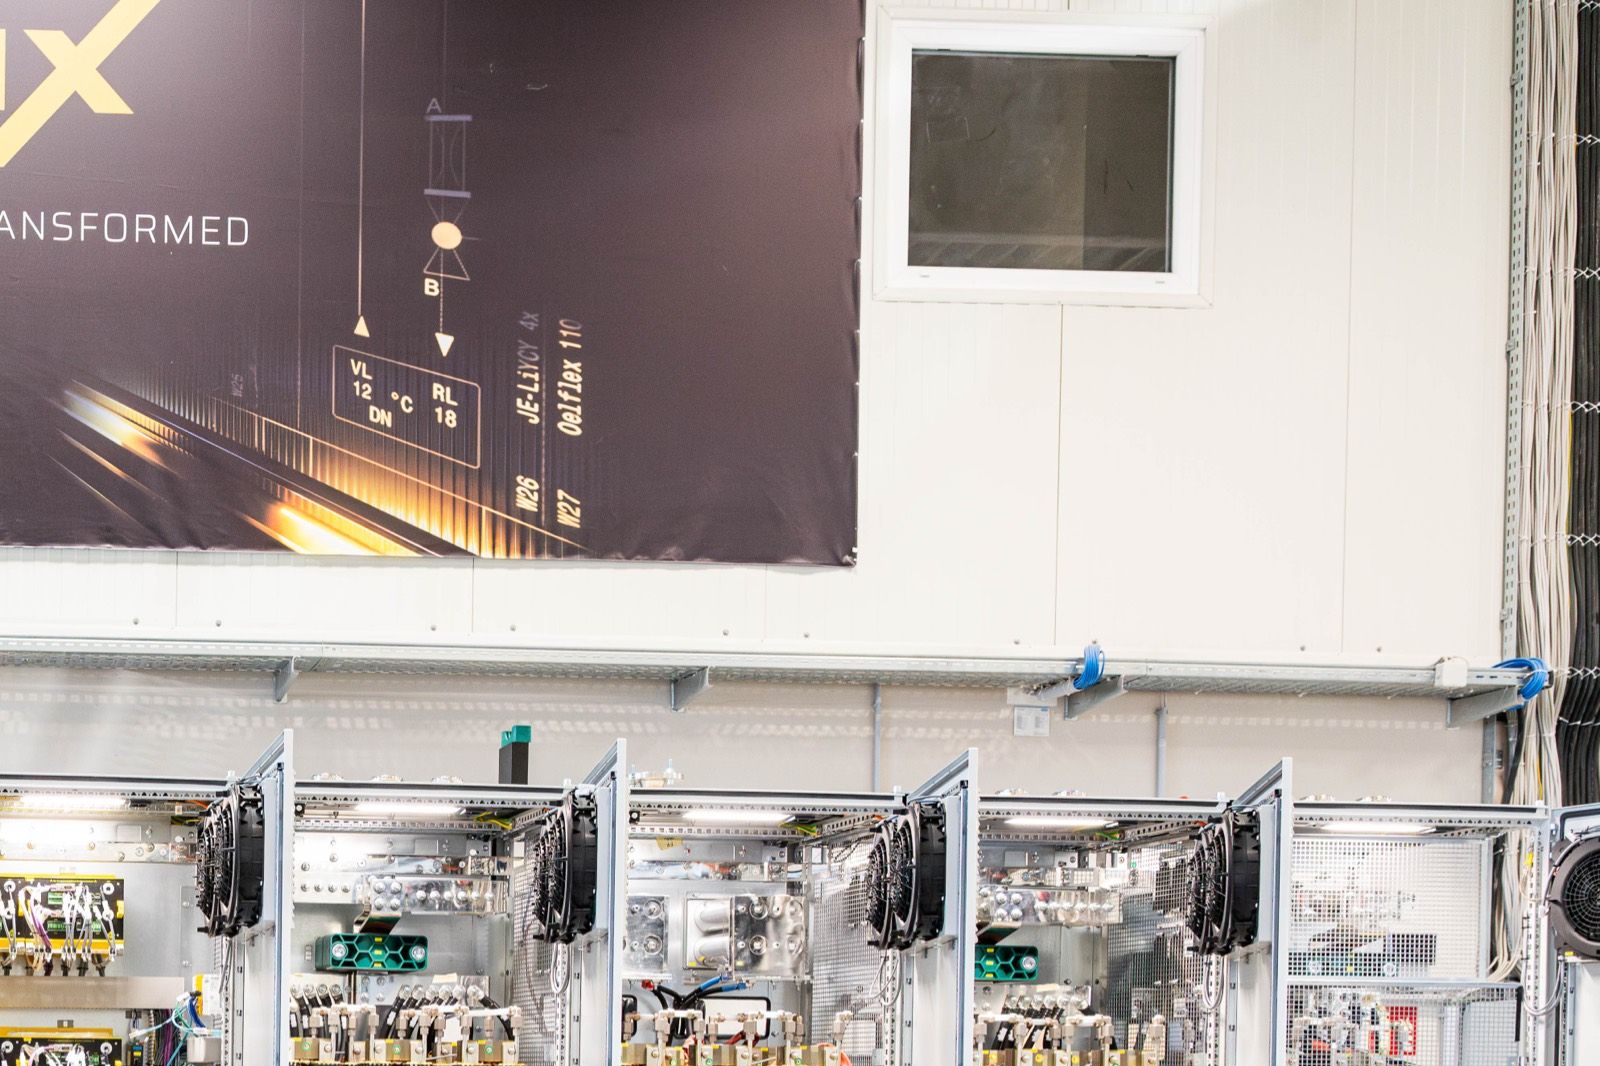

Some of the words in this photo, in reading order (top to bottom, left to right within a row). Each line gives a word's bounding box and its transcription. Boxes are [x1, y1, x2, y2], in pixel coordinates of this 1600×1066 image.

[426, 97, 442, 113] A
[425, 279, 440, 297] B
[558, 318, 582, 348] 110
[350, 359, 373, 380] VL
[353, 381, 372, 400] 12
[433, 383, 458, 406] RL
[557, 359, 582, 436] Oelflex
[368, 405, 393, 428] DN
[435, 407, 457, 428] 18
[516, 475, 540, 512] W26
[557, 489, 582, 528] W27
